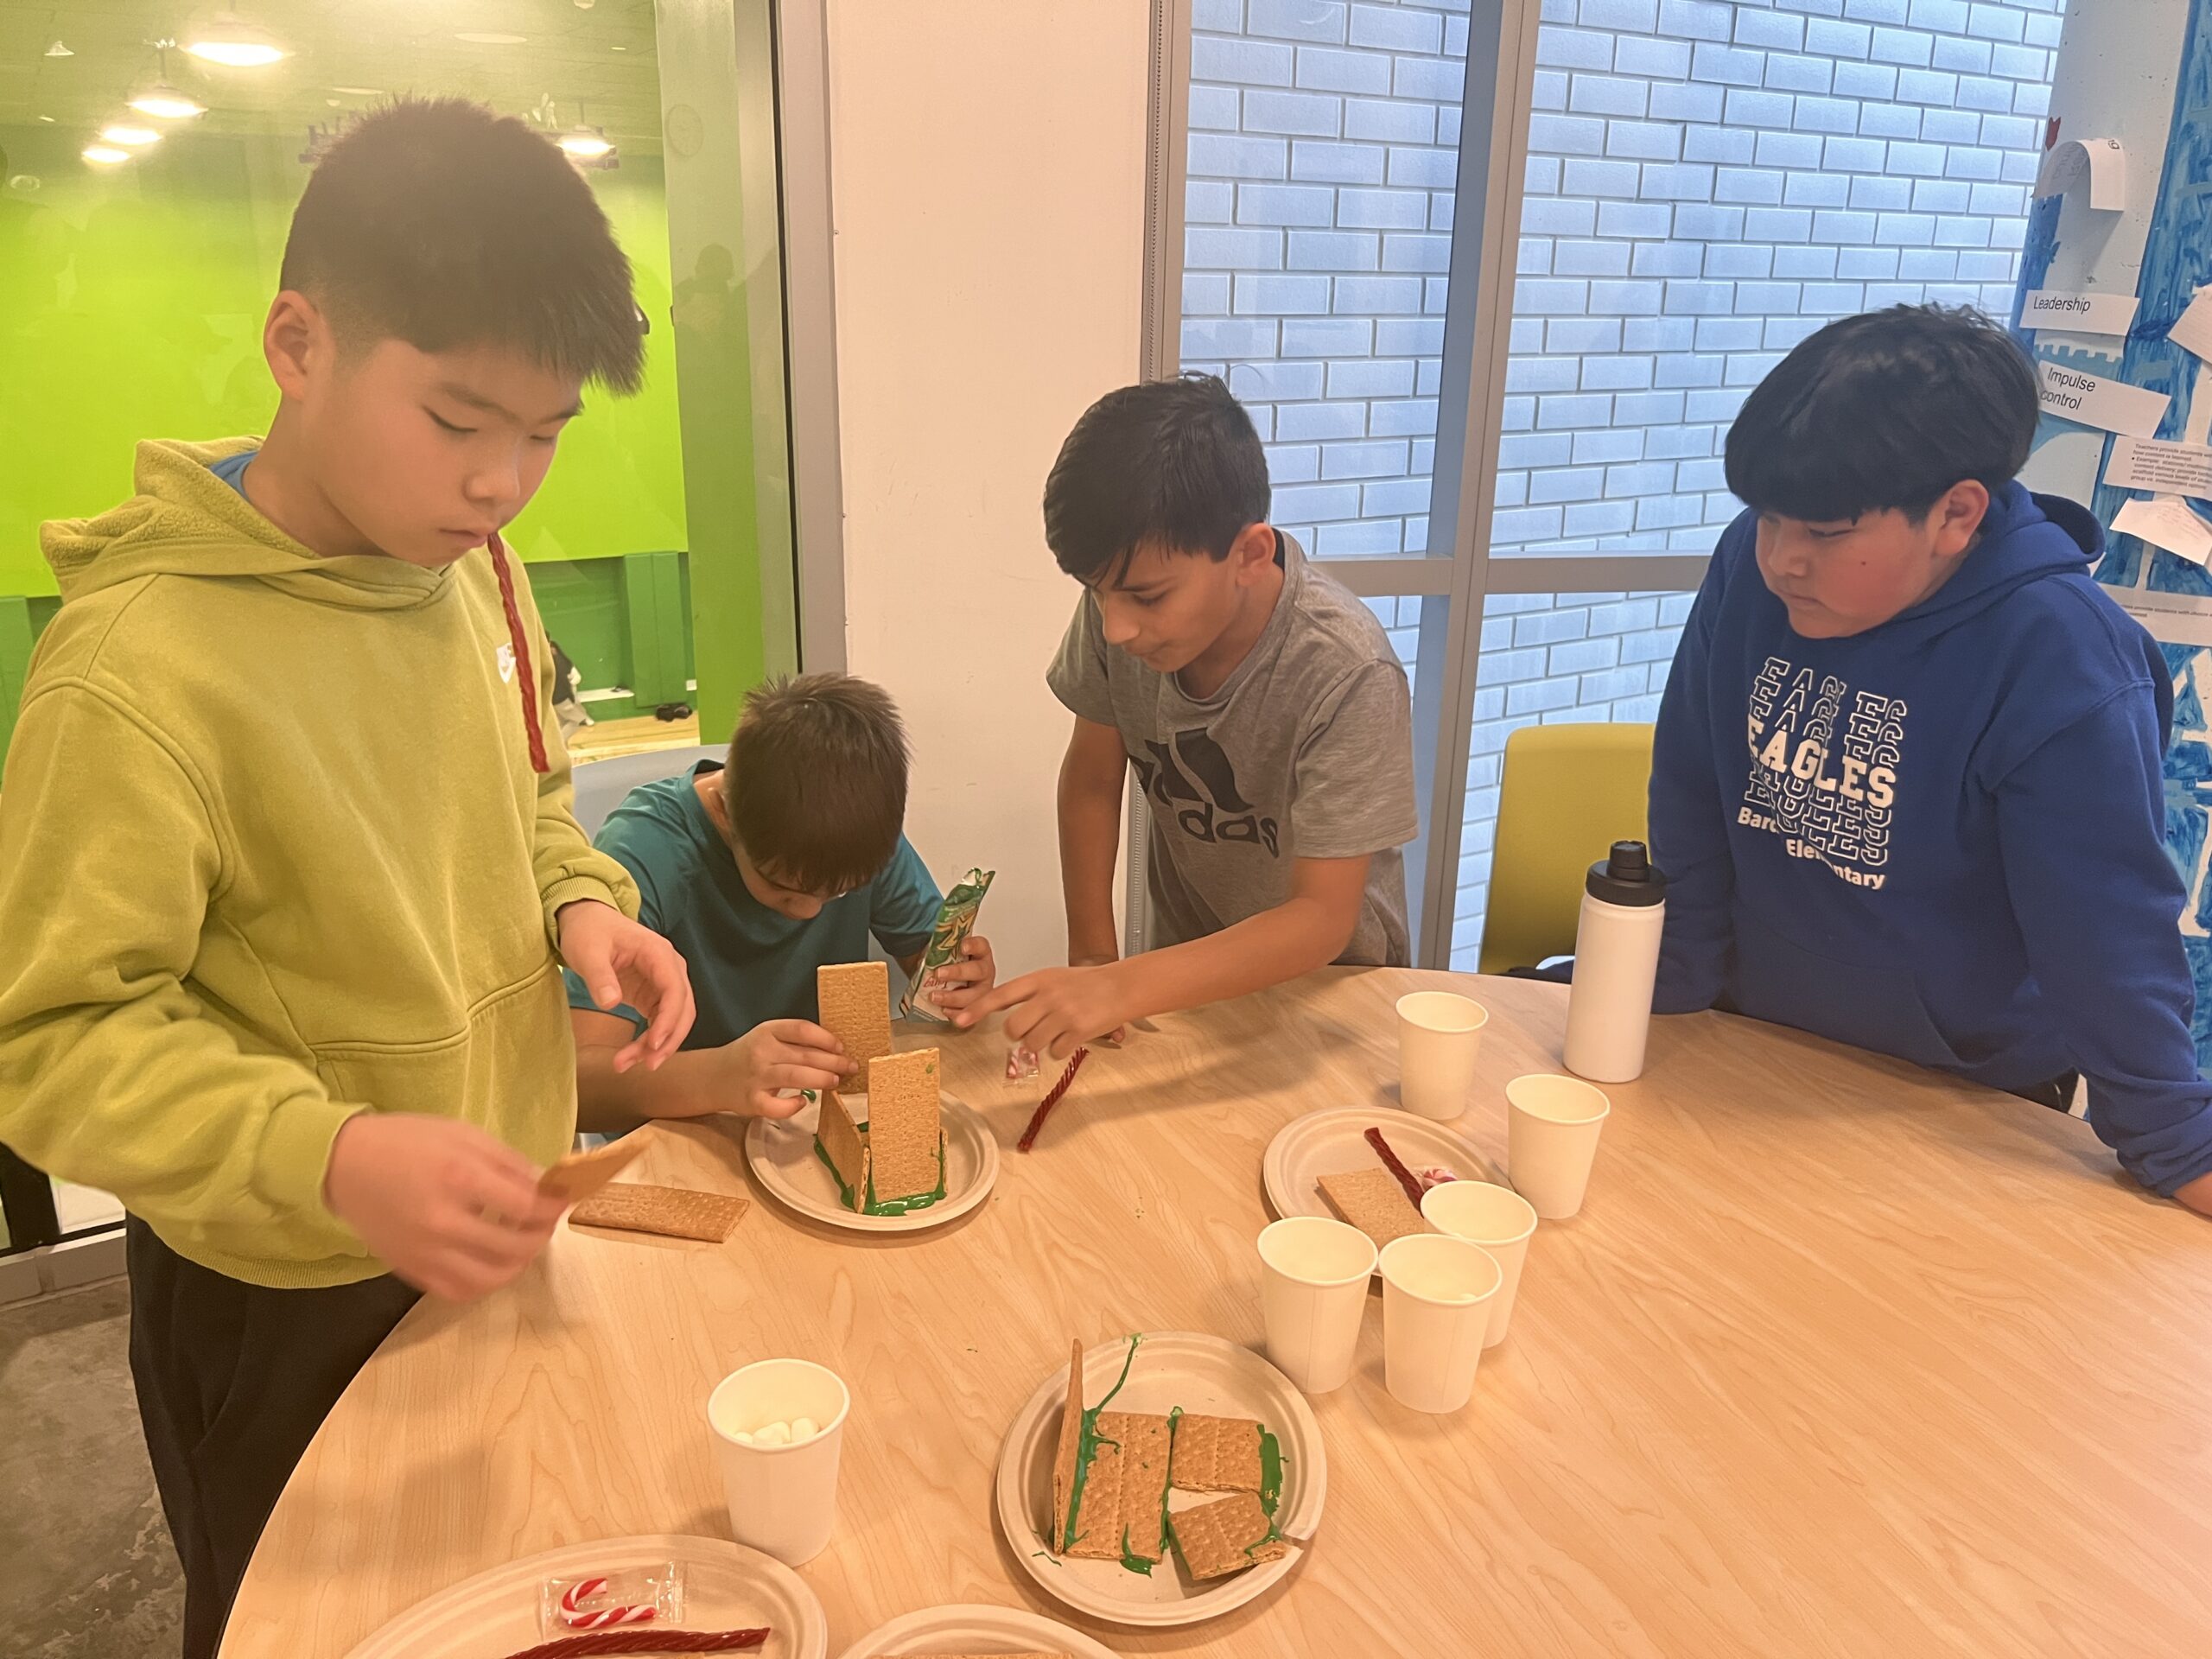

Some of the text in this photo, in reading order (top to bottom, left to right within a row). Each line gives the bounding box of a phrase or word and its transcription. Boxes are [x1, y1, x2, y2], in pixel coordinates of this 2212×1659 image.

[2033, 296, 2091, 315] Leadership
[2047, 367, 2095, 391] Impulse
[2040, 390, 2082, 410] control
[1747, 713, 1897, 809] EAGLES
